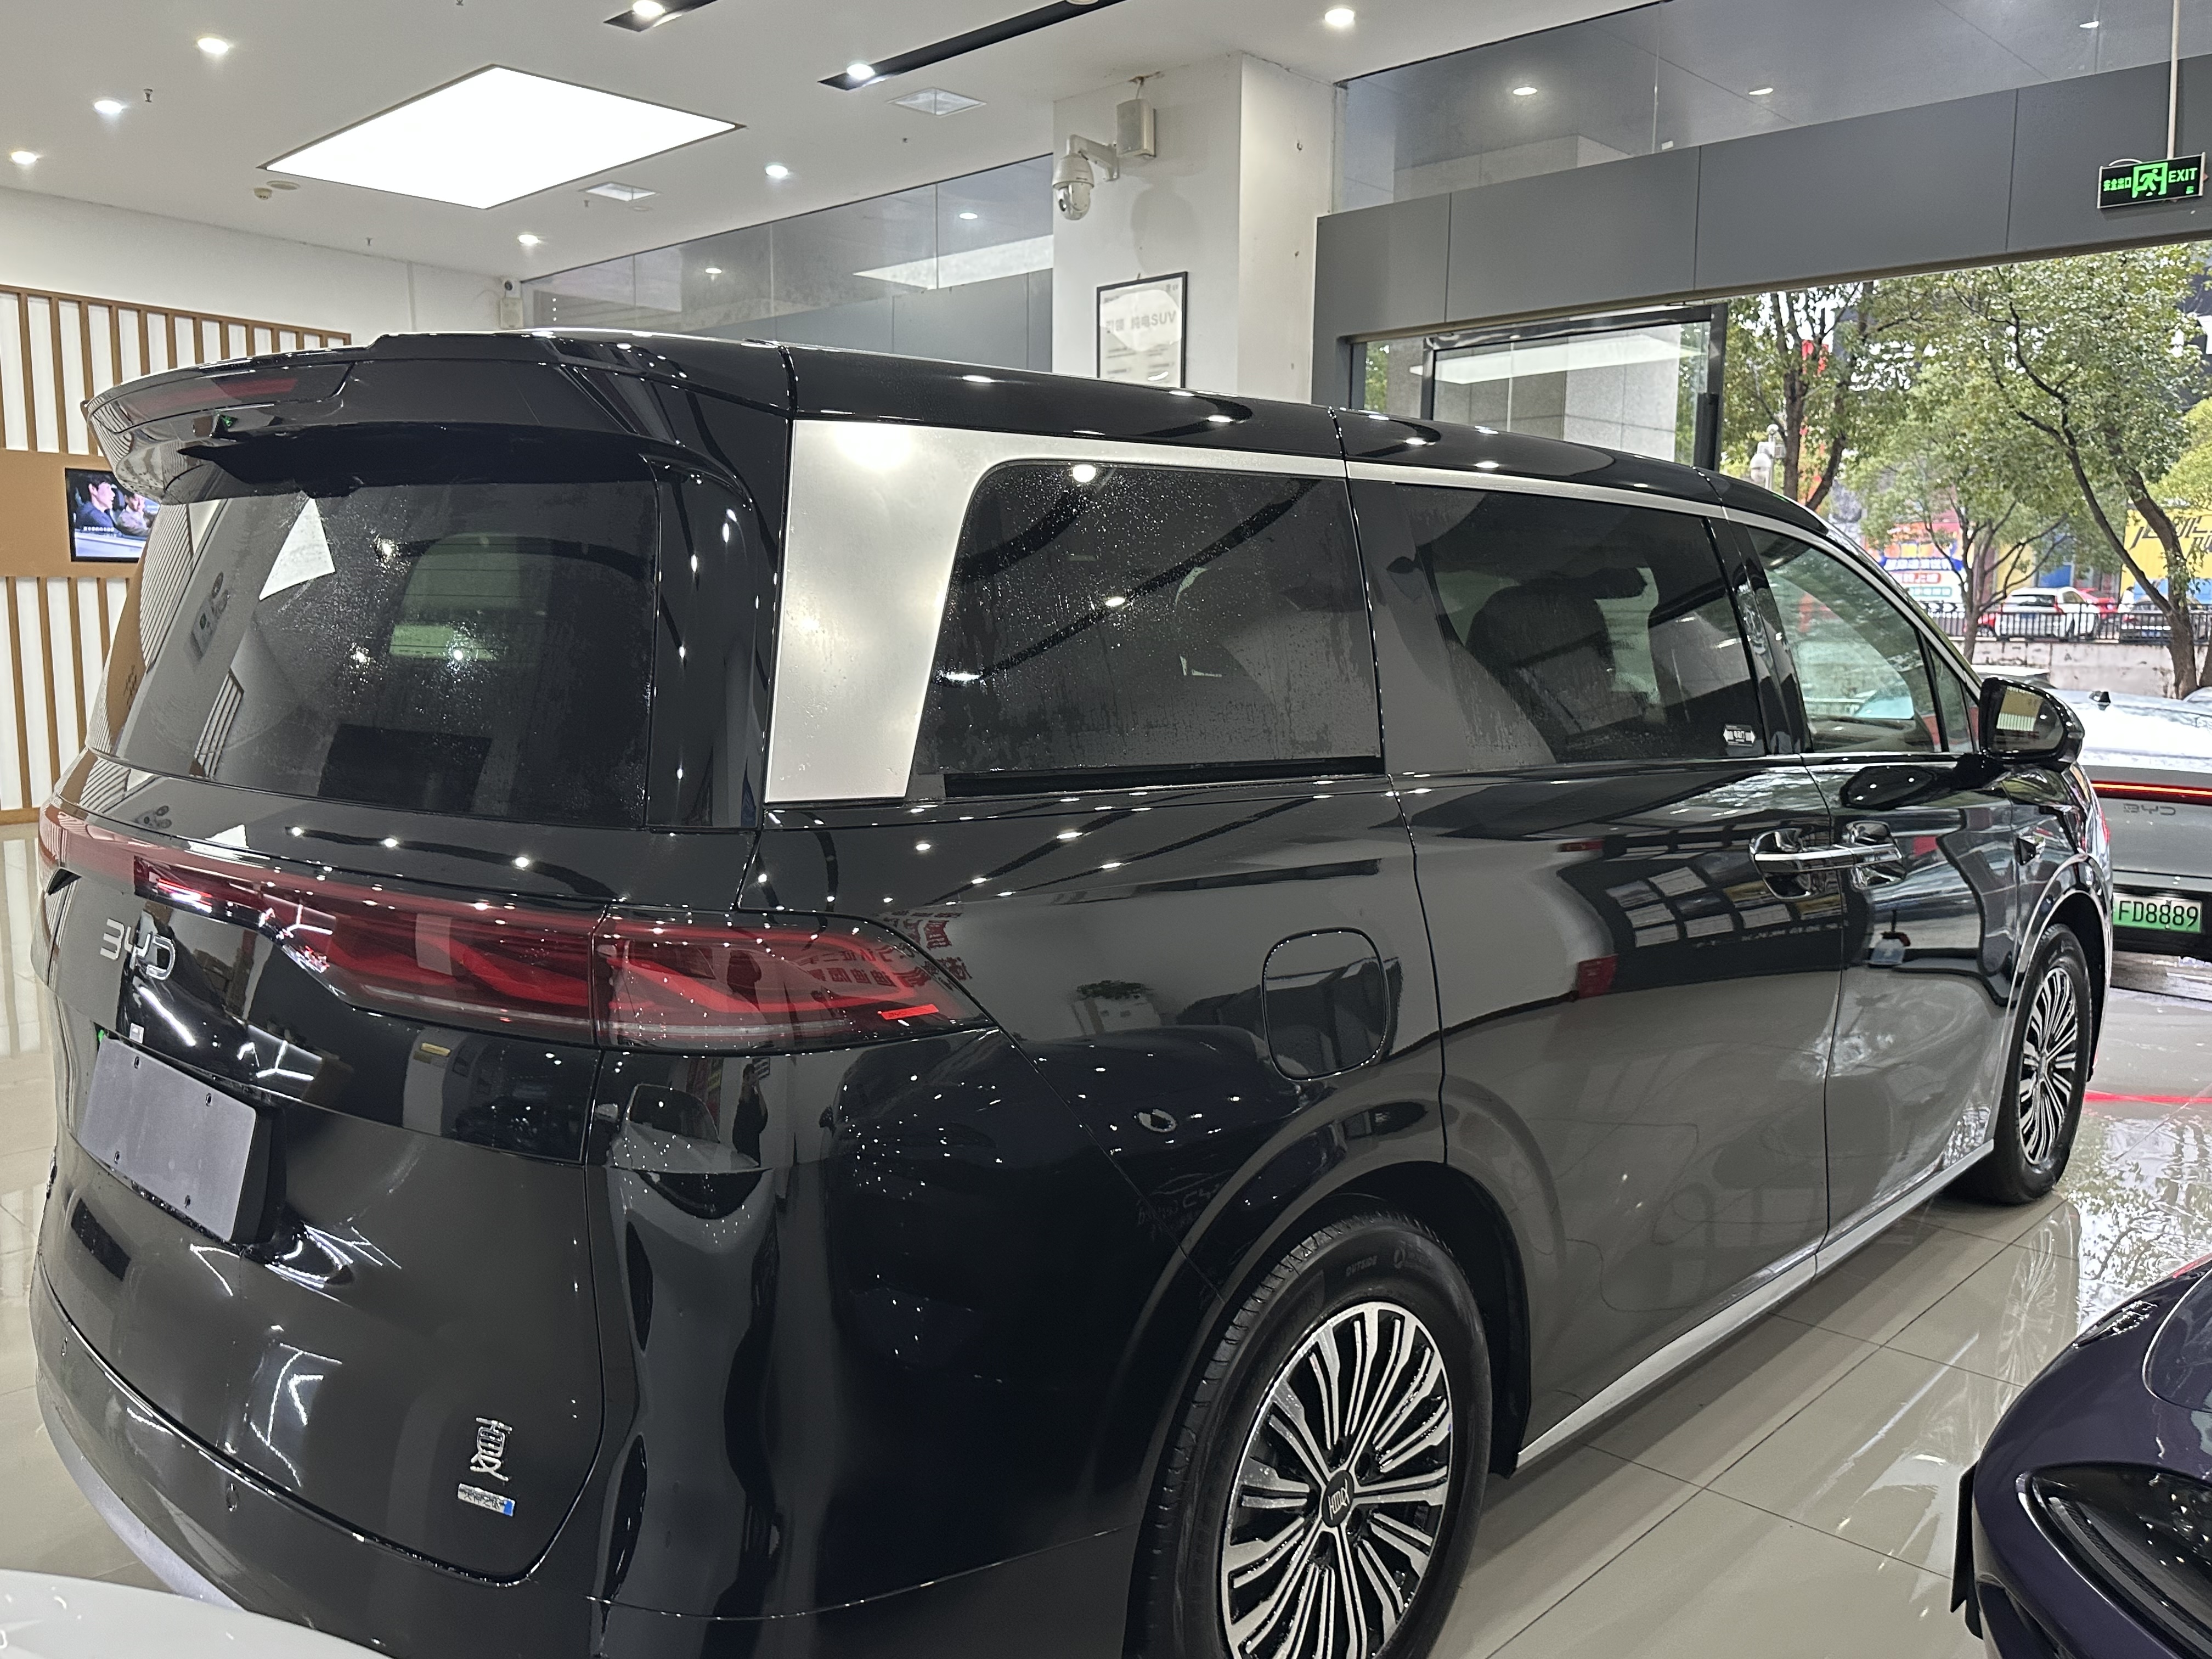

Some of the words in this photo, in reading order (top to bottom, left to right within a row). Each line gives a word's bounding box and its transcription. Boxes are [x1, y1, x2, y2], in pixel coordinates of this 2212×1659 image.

[2168, 167, 2198, 183] EXIT
[2123, 803, 2176, 816] BYD
[2119, 900, 2199, 927] FD8889
[100, 917, 176, 980] BYD
[470, 1417, 512, 1482] 夏
